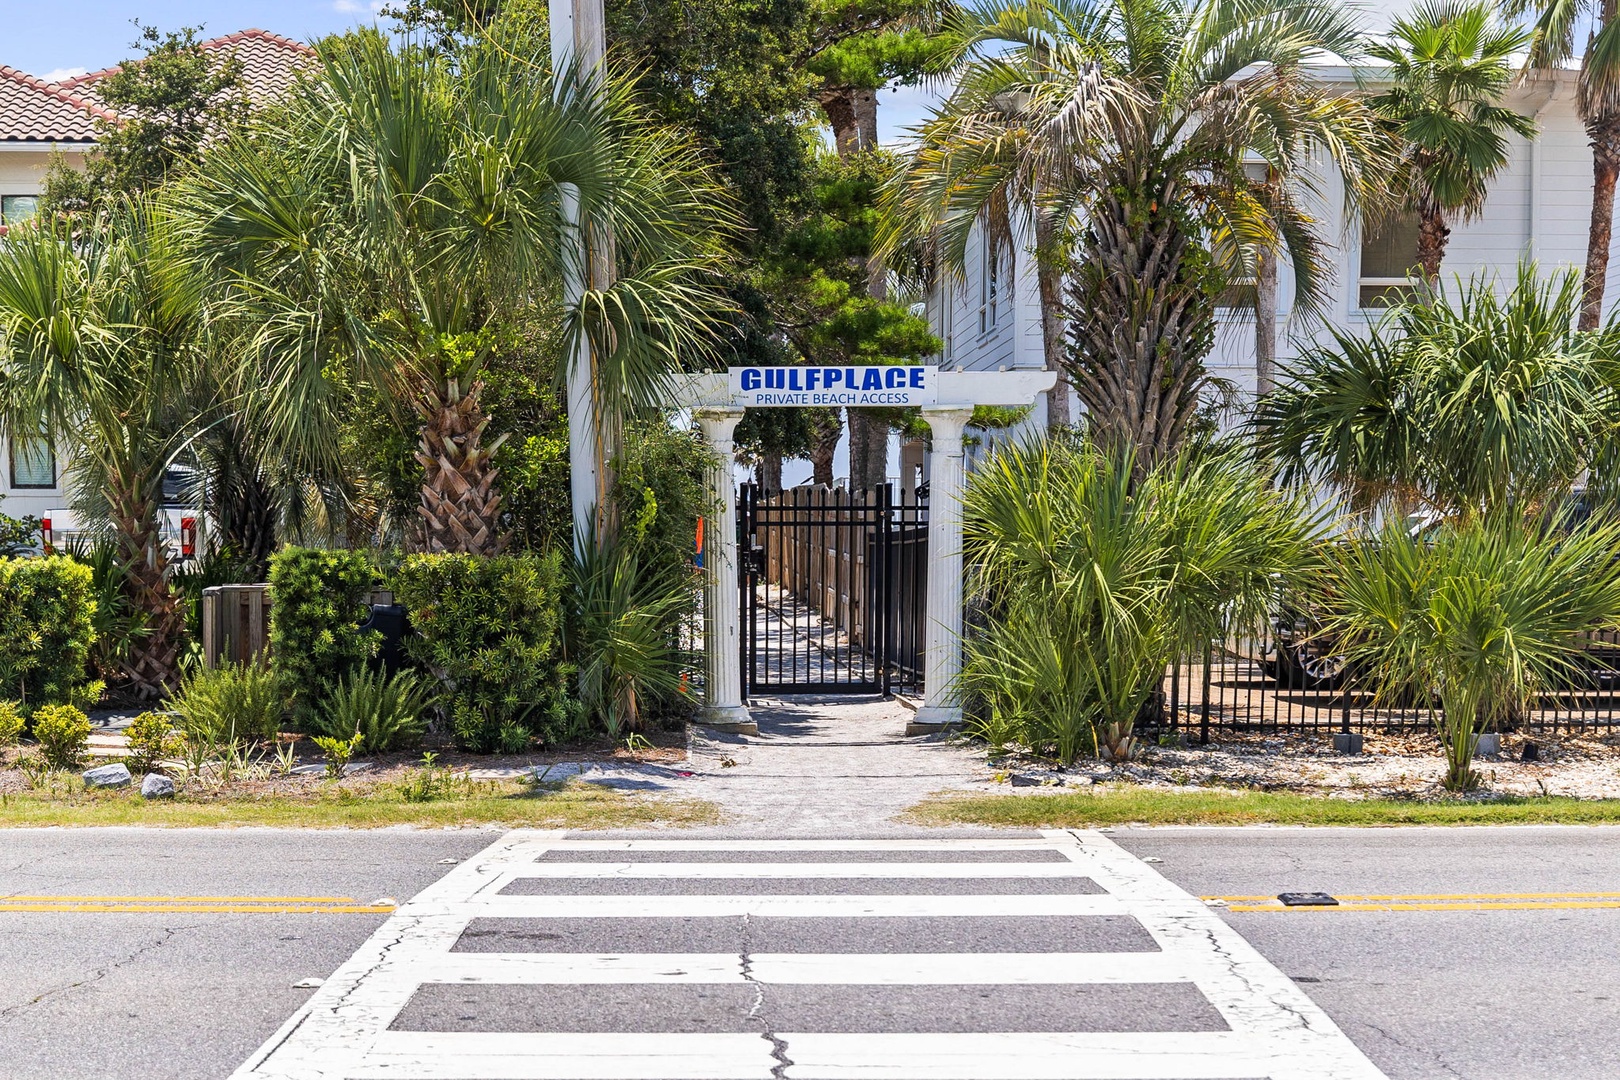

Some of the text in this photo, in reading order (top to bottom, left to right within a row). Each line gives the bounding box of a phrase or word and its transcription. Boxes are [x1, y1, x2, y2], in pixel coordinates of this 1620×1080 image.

[741, 367, 925, 391] GULFPLACE
[756, 393, 909, 404] PRIVATE BEACH ACCESS
